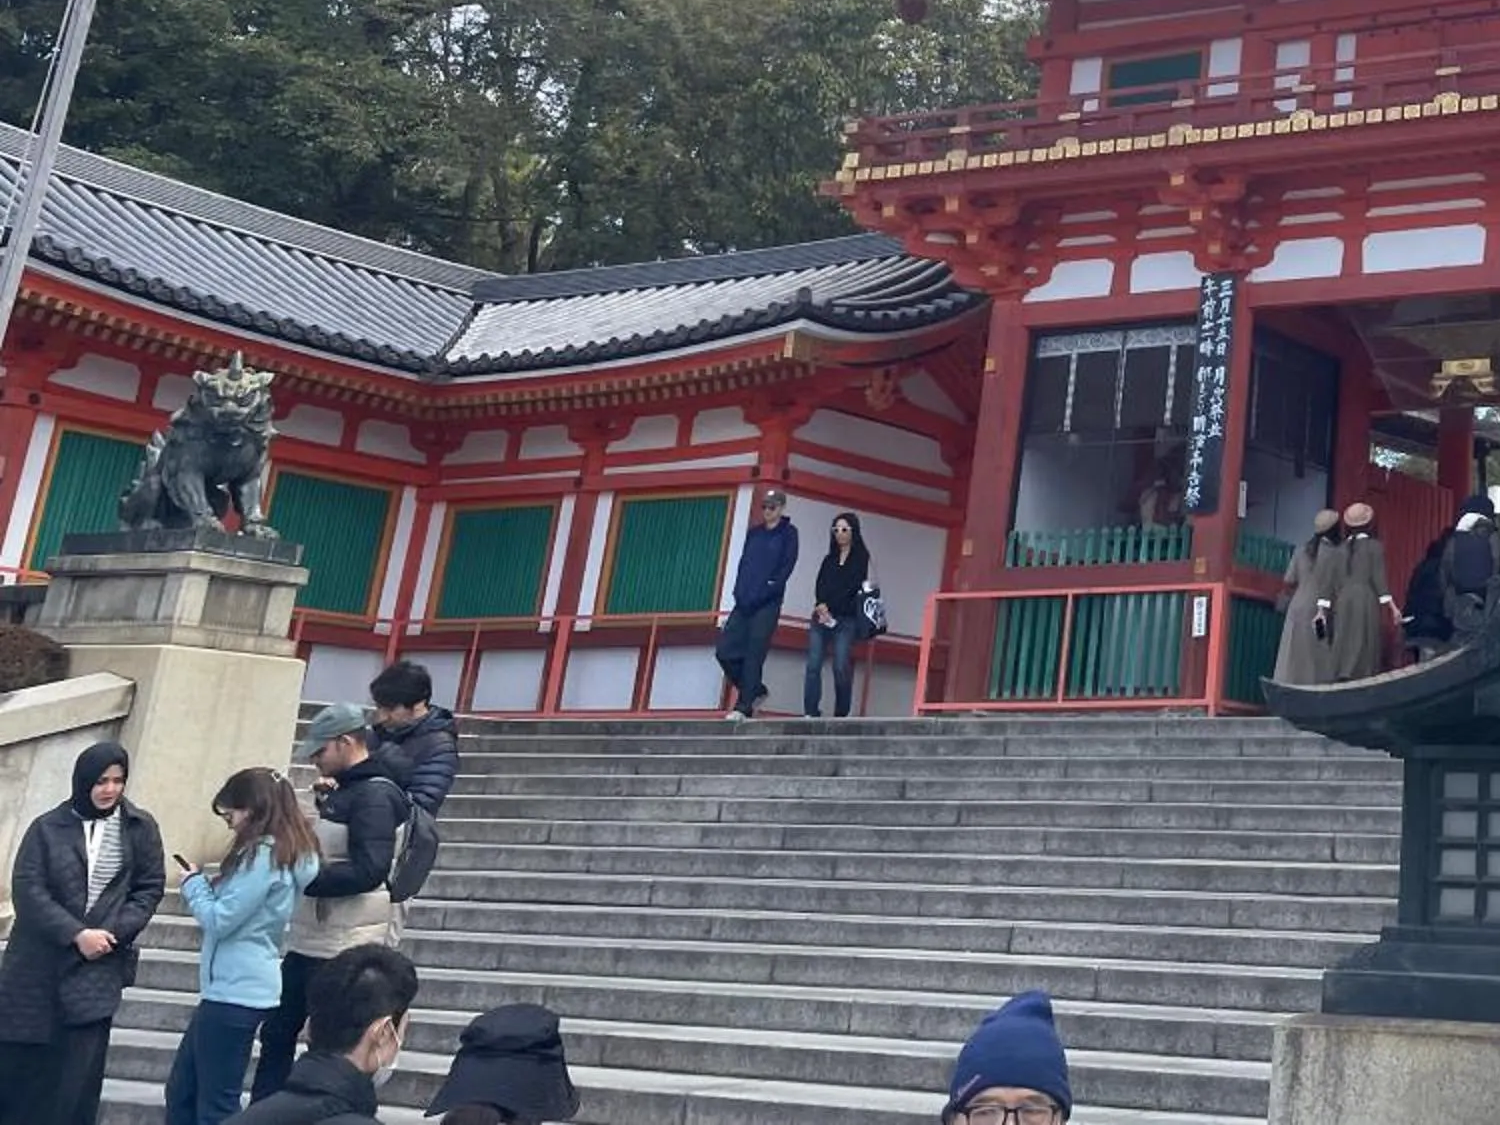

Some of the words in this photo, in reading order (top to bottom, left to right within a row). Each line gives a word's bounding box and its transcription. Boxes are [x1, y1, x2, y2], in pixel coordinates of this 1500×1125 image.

[1199, 277, 1219, 358] 午前十一時
[1215, 279, 1233, 356] 三月十五日
